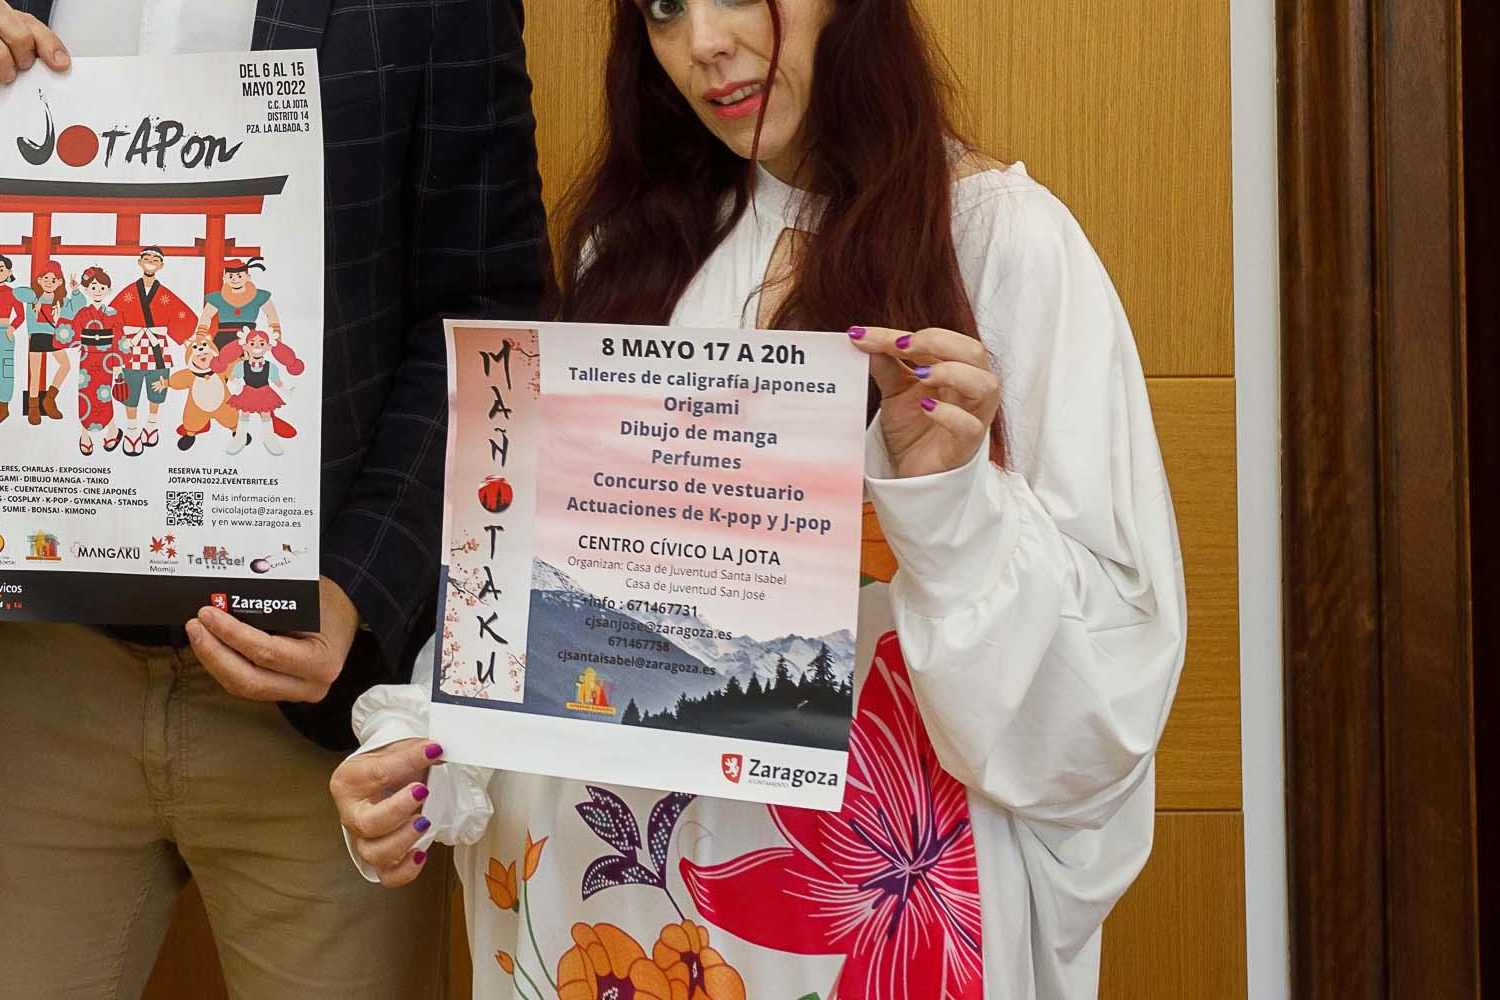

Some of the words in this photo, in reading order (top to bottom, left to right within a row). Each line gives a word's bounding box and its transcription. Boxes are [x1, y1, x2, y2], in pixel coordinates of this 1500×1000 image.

[240, 64, 261, 79] DEL
[263, 63, 270, 77] 6
[273, 63, 288, 77] AL
[291, 62, 304, 77] 15
[243, 81, 273, 97] MAYO
[277, 80, 306, 96] 2022
[268, 100, 281, 110] C.C.
[282, 100, 291, 109] LA
[293, 99, 308, 109] JOTA
[268, 111, 298, 121] DISTRITO
[301, 111, 309, 120] 14
[602, 338, 615, 356] 8
[622, 339, 695, 360] MAYO
[703, 342, 730, 361] 17
[737, 344, 754, 363] A
[761, 345, 805, 365] 20h
[569, 367, 636, 383] Talleres
[642, 370, 662, 385] de
[667, 372, 749, 391] caligrafía
[752, 376, 836, 395] Japonesa
[664, 397, 739, 418] Origami
[621, 421, 679, 442] Dibujo
[686, 424, 707, 440] de
[713, 430, 777, 448] manga
[652, 450, 741, 470] Perfumes
[168, 477, 279, 486] JOTAPON2022.EVENTBRITE.ES
[594, 472, 679, 492] Concurso
[685, 478, 707, 494] de
[712, 484, 804, 501] vestuario
[212, 506, 314, 517] civicolajota@zaragoza.es
[567, 497, 677, 519] Actuaciones
[682, 505, 704, 521] de
[710, 508, 762, 530] K-pop
[767, 515, 778, 531] y
[781, 513, 831, 535] J-pop
[579, 535, 645, 554] CENTRO
[651, 539, 707, 559] CÍVICO
[713, 546, 734, 562] LA
[738, 549, 780, 566] JOTA
[568, 556, 624, 570] Organizan:
[627, 561, 651, 573] Casa
[654, 564, 667, 574] de
[669, 565, 718, 579] Juventud
[720, 570, 751, 582] Santa
[755, 573, 786, 585] Isabel
[626, 578, 650, 590] Casa
[654, 581, 666, 591] de
[668, 582, 717, 596] Juventud
[720, 587, 740, 598] San
[742, 589, 766, 601] José
[231, 595, 297, 613] Zaragoza
[626, 600, 698, 617] 671467731
[585, 616, 733, 641] cjsanjose@zaragoza.es
[557, 650, 716, 676] cjsantaisabel@zaragoza.es
[748, 759, 838, 788] Zaragoza
